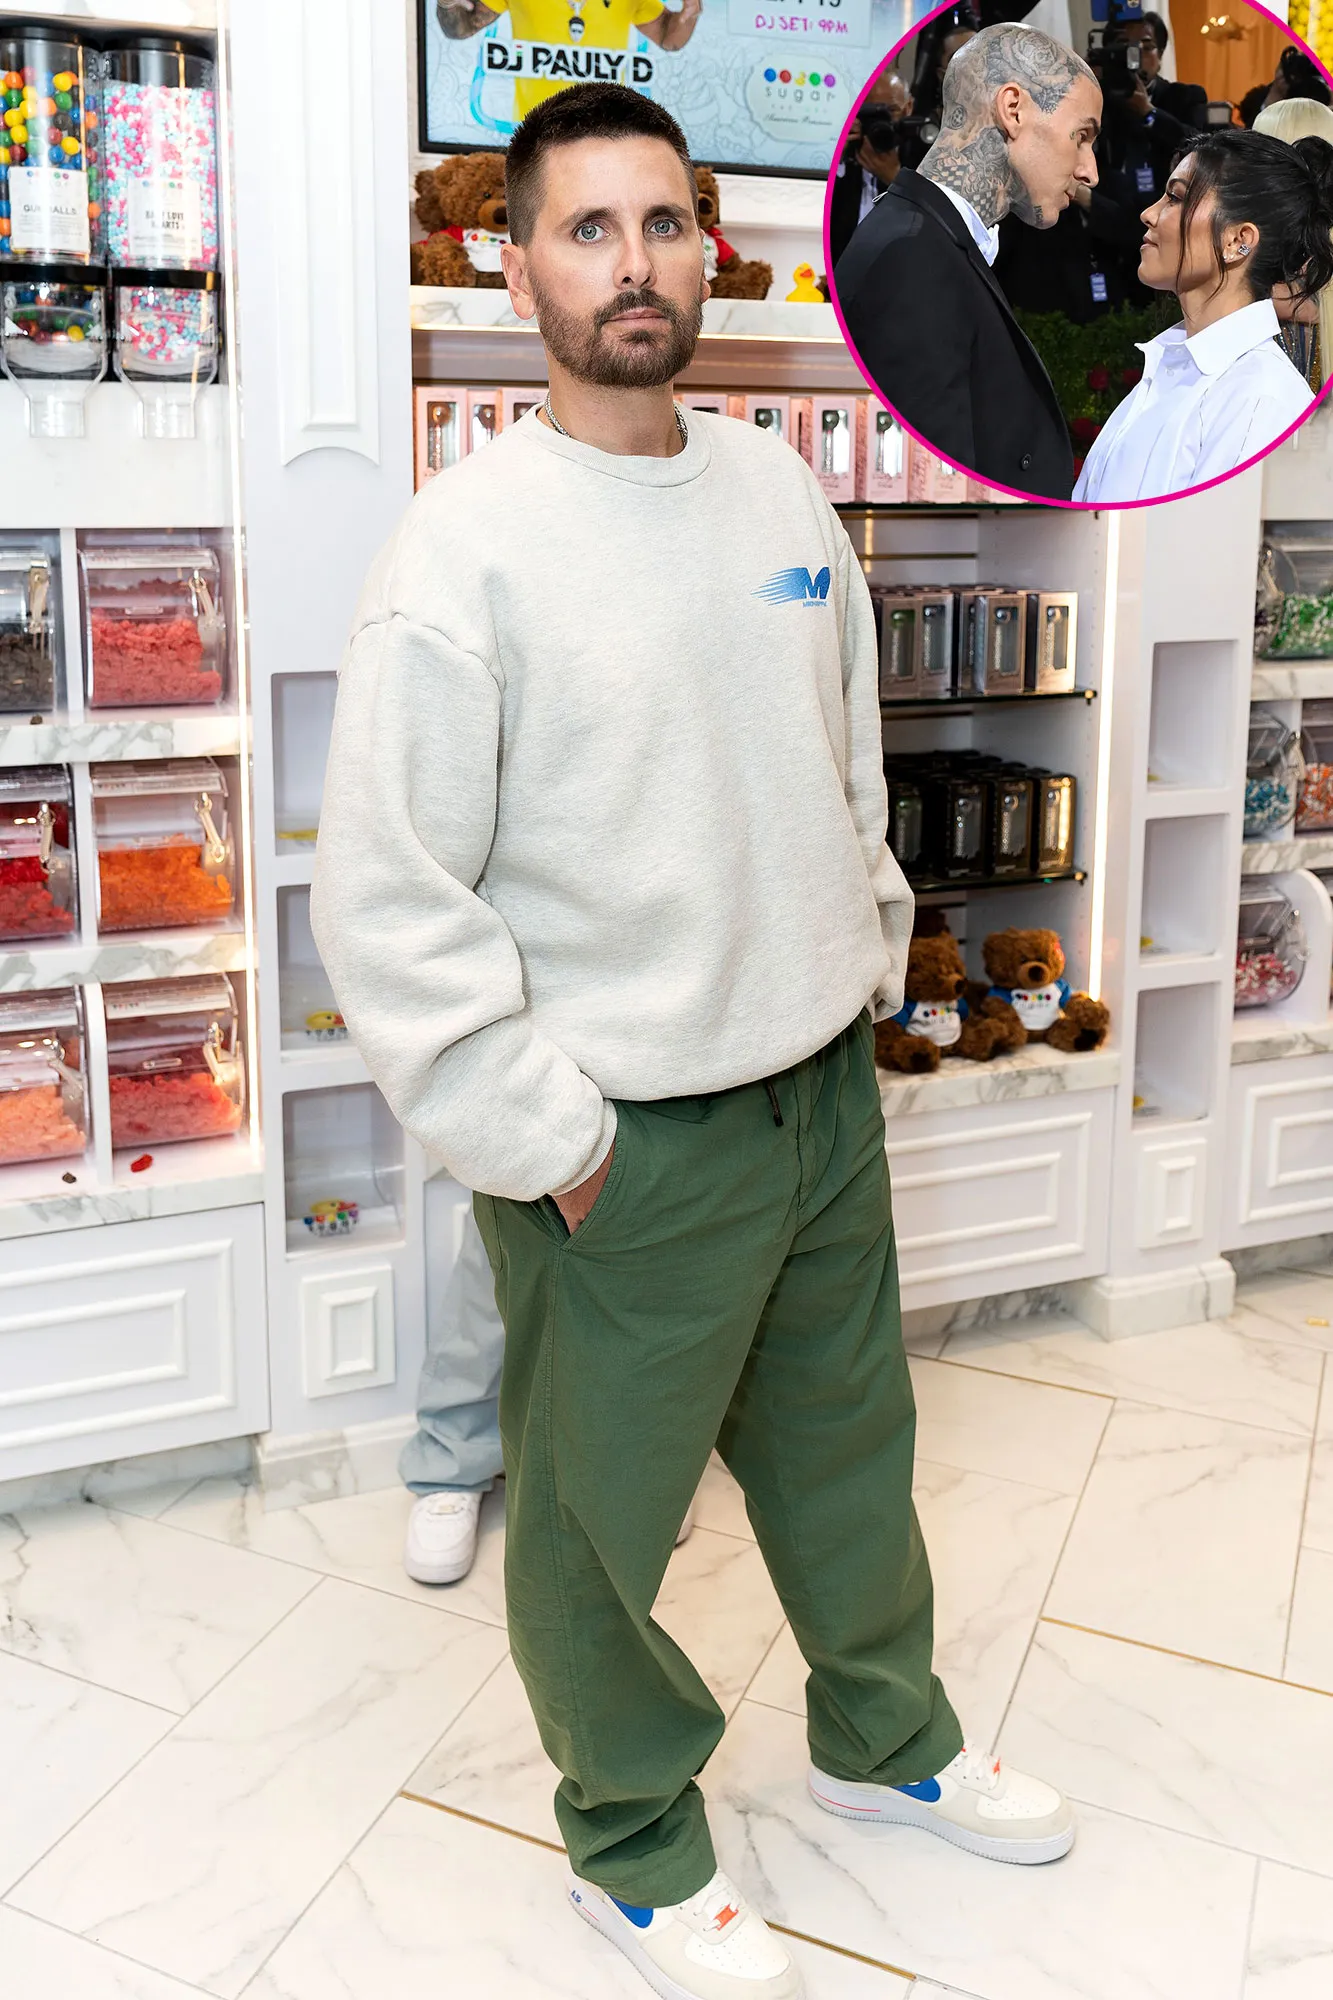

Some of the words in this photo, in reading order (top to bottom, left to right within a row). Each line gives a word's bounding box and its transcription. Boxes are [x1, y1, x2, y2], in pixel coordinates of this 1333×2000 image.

[755, 14, 775, 30] DJ
[532, 46, 625, 80] PAULY
[632, 56, 654, 83] D
[765, 86, 836, 103] sugar
